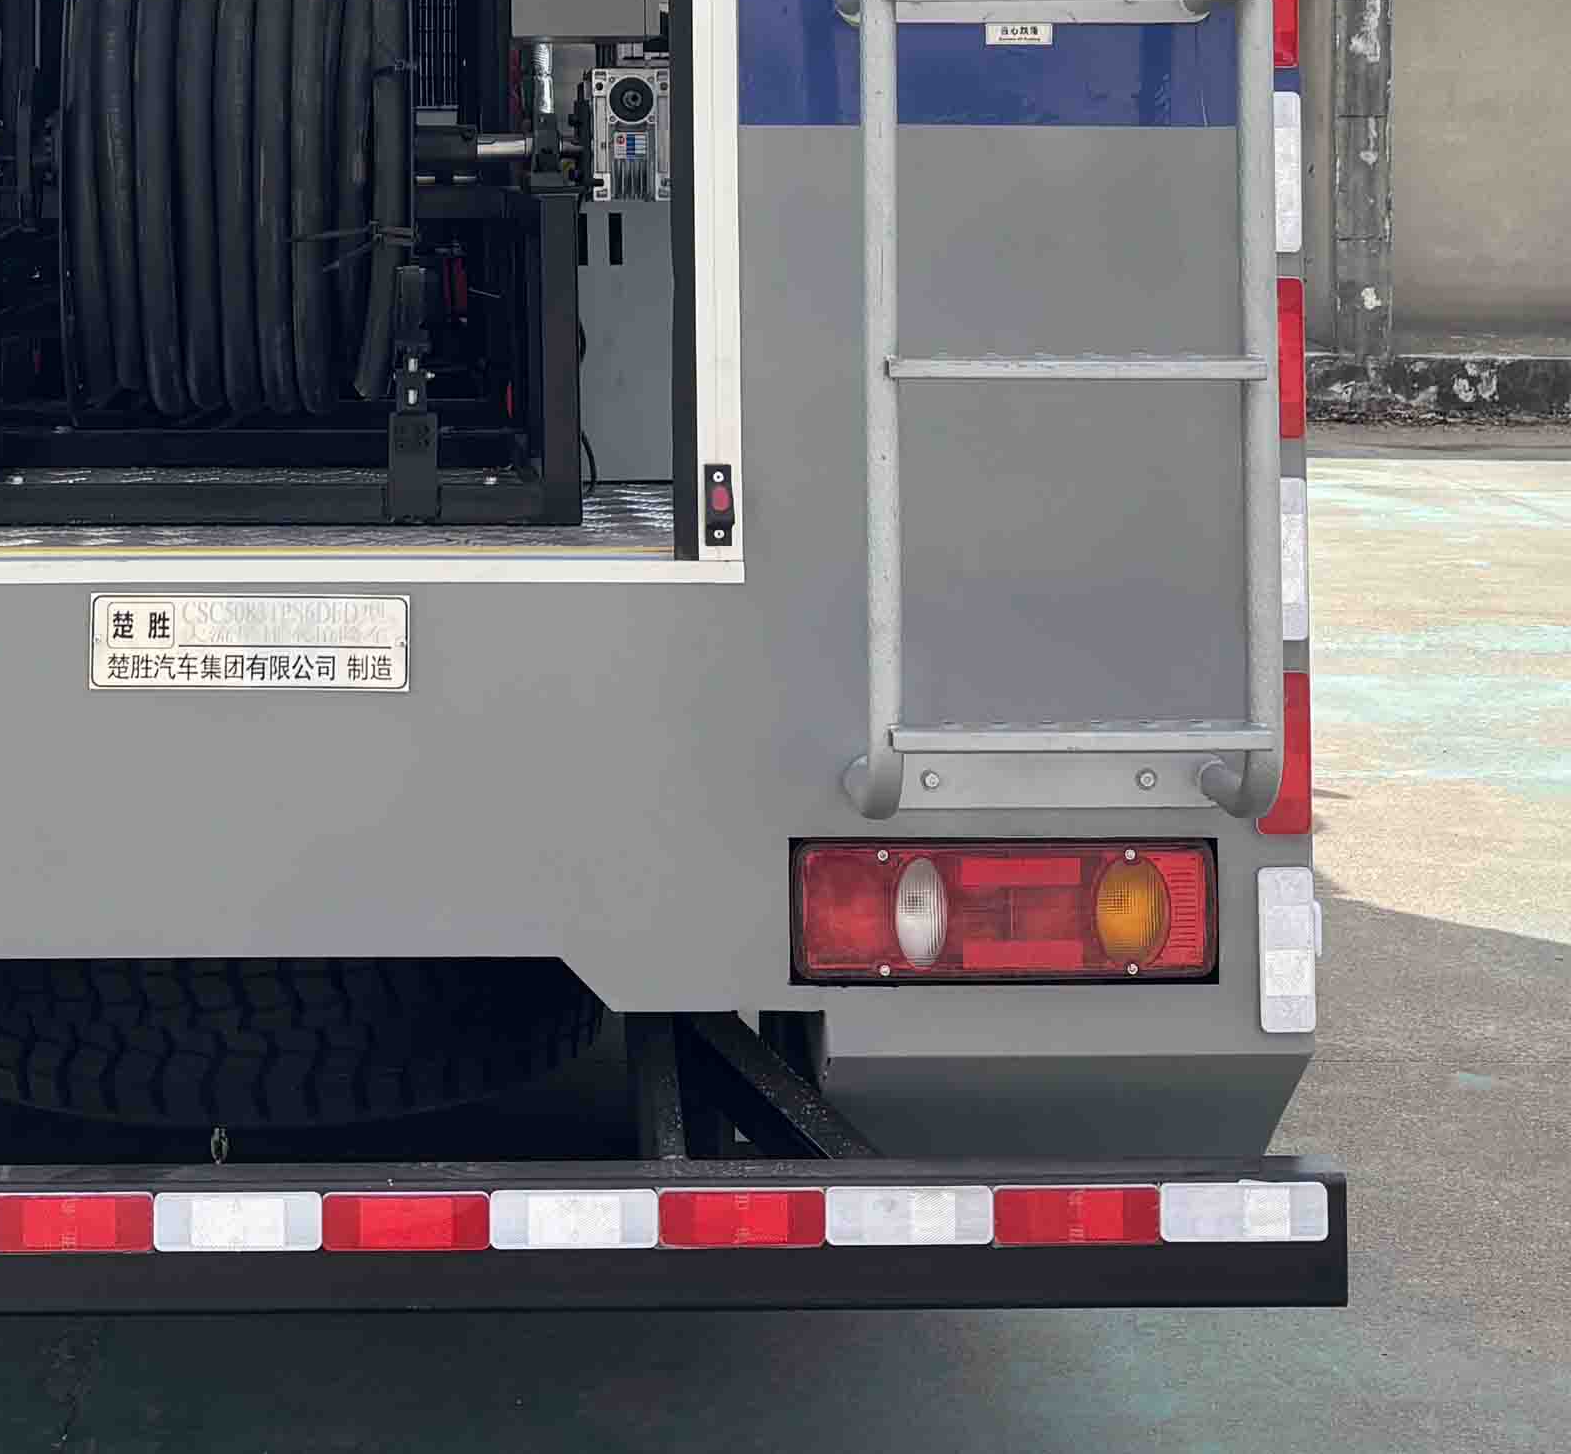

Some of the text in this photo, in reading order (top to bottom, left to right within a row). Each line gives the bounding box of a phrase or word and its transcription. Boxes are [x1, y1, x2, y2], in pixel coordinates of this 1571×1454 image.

[106, 652, 393, 682] 楚胜汽车集团有限公司 制造
